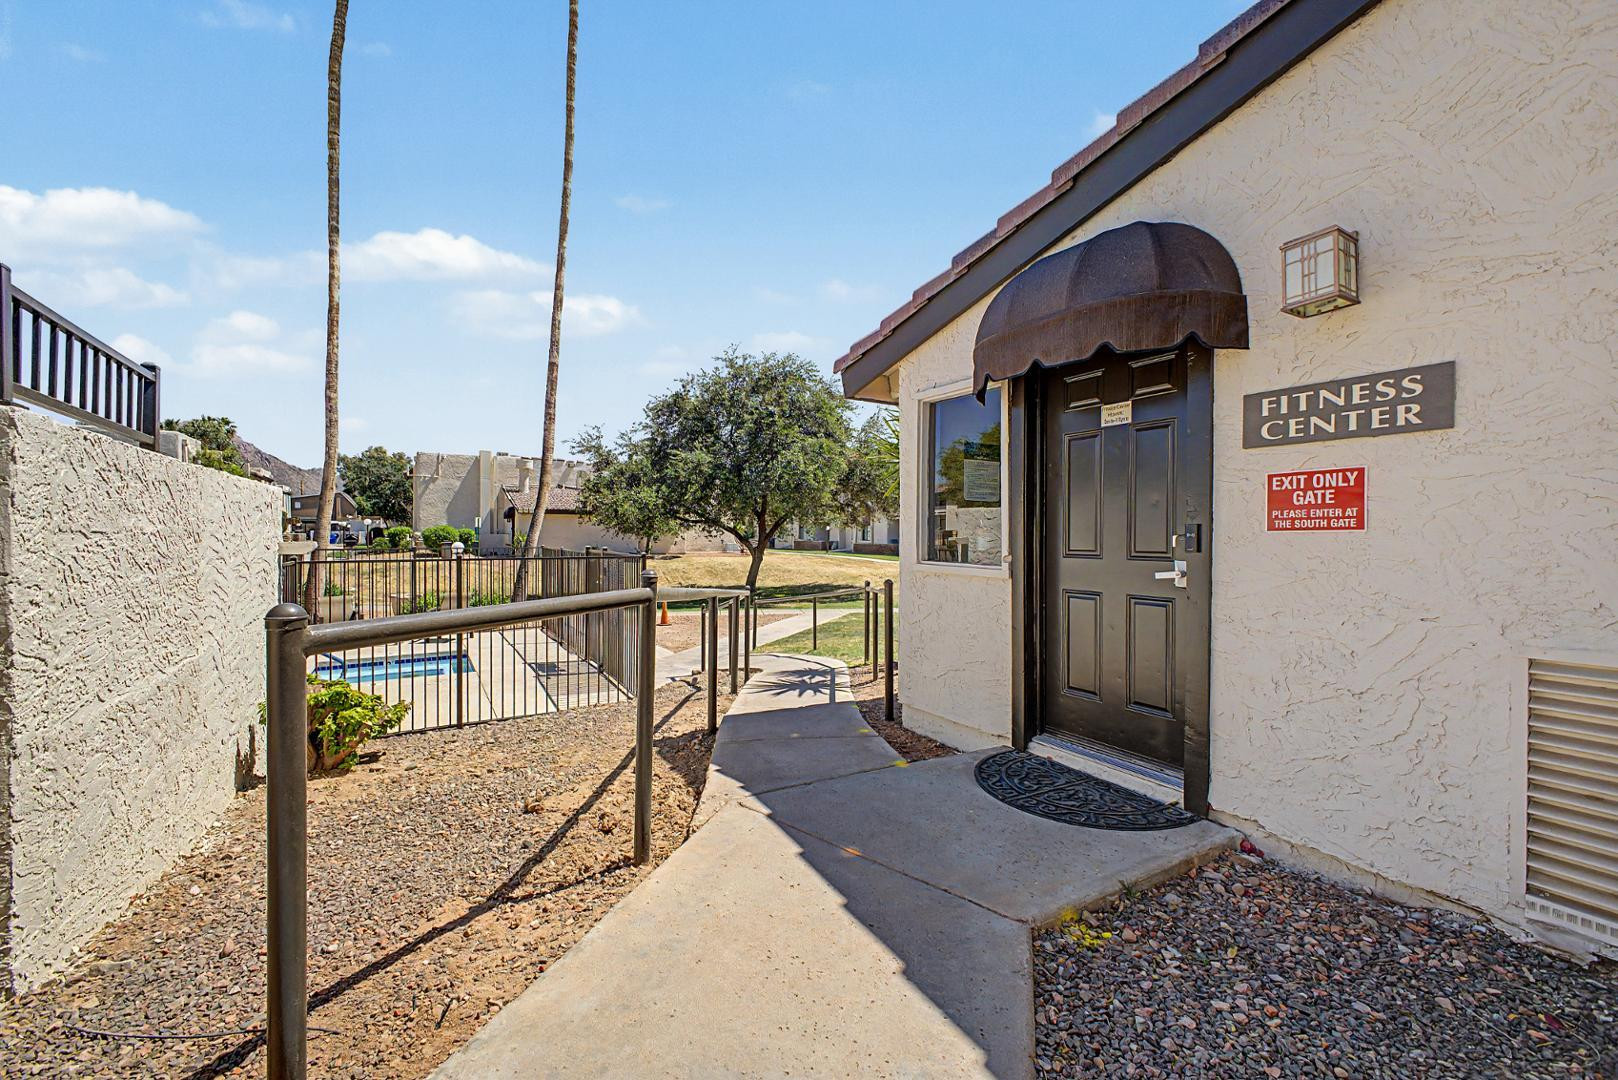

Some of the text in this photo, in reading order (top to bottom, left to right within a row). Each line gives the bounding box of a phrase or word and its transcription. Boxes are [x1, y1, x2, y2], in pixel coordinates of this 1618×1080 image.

[1261, 374, 1424, 417] FITNESS
[1260, 403, 1423, 440] CENTER
[1272, 471, 1359, 490] EXIT ONLY
[1293, 489, 1335, 505] GATE
[1272, 507, 1358, 519] PLEASE ENTER AT
[1274, 518, 1358, 529] THE SOUTH GATE
